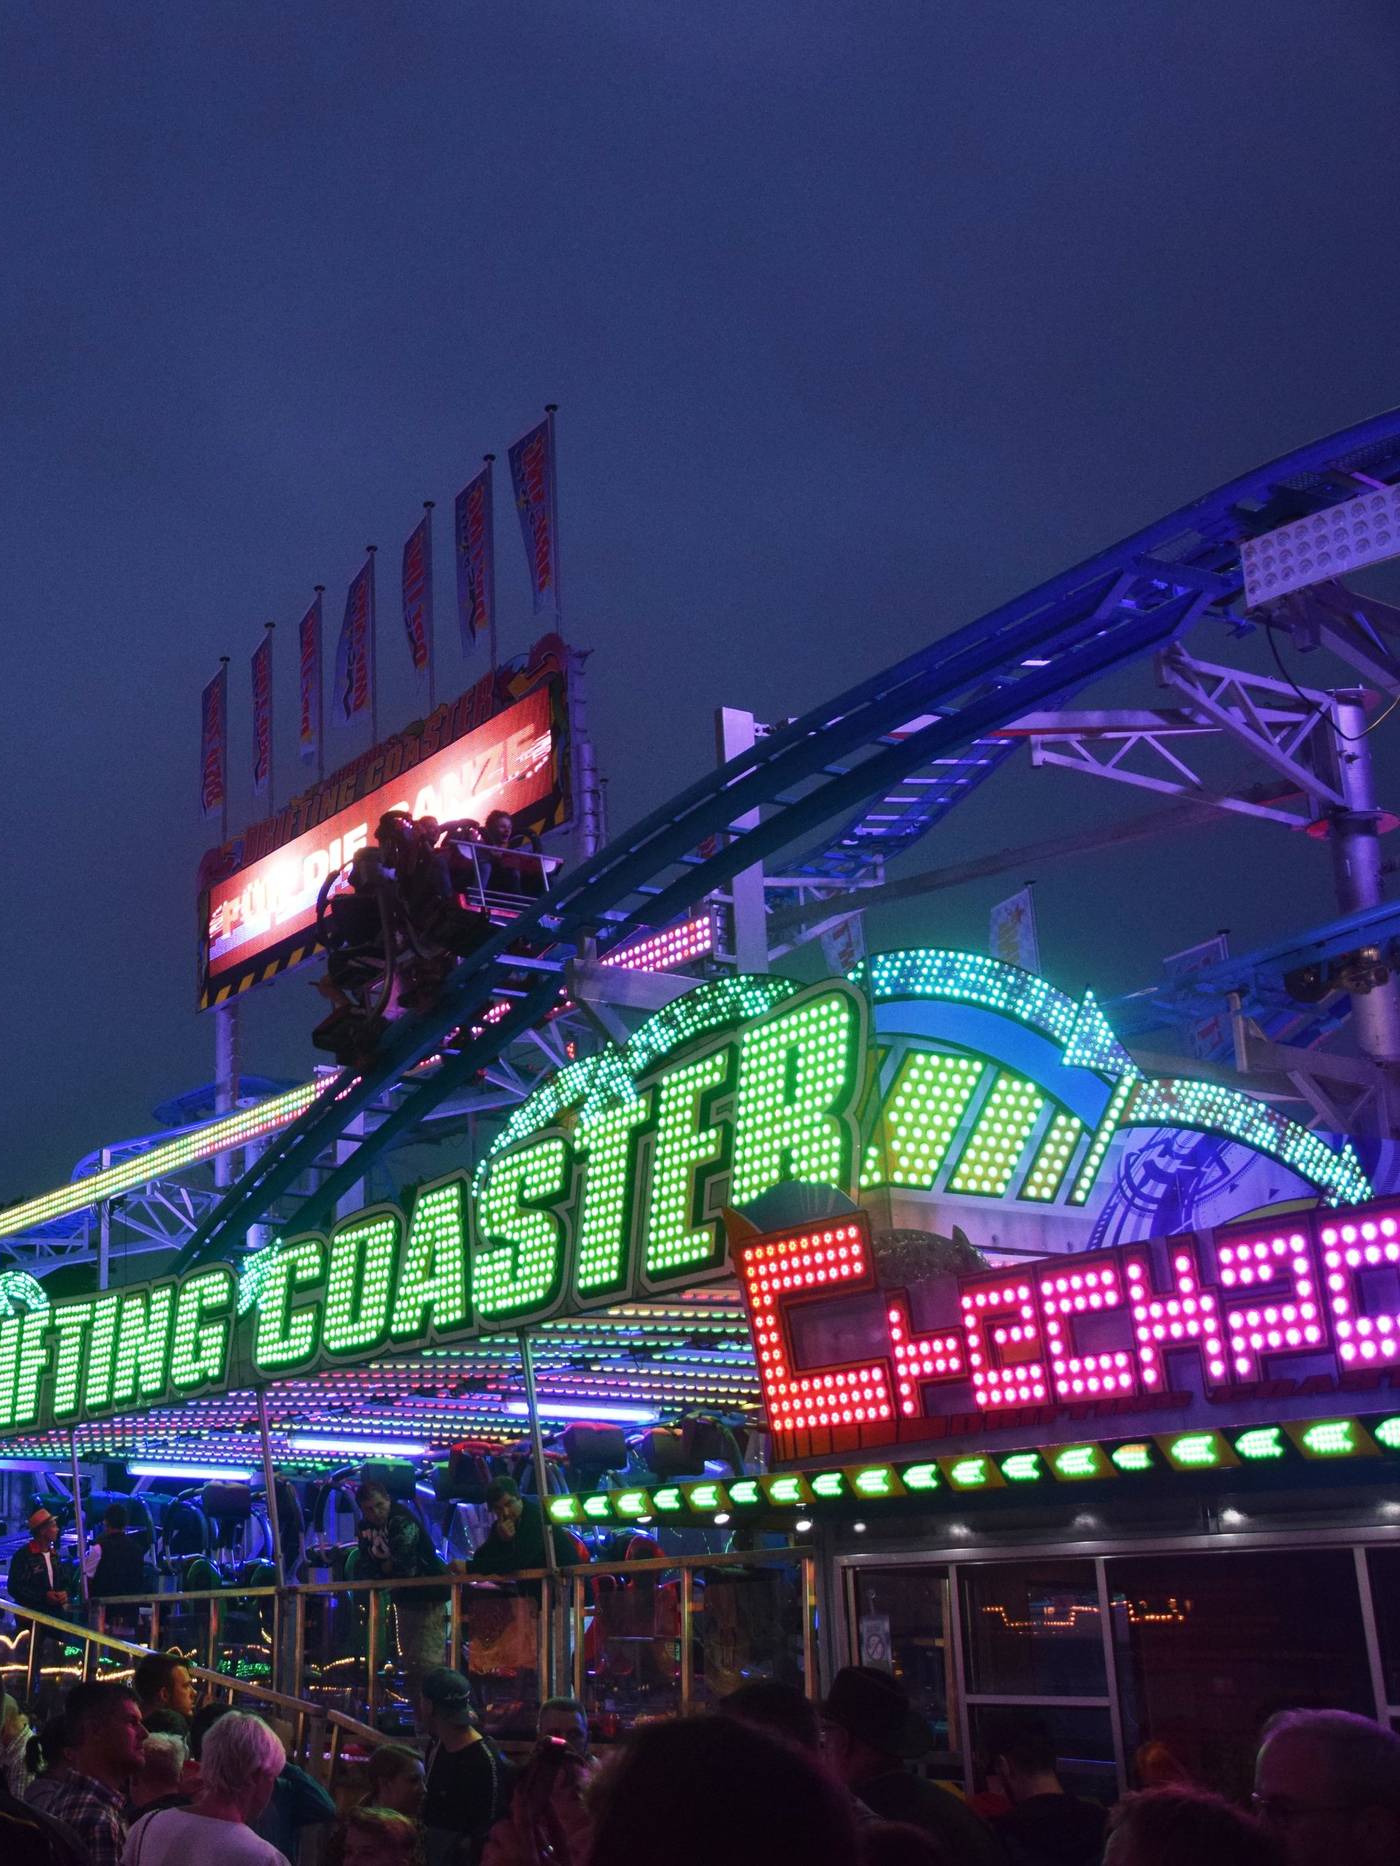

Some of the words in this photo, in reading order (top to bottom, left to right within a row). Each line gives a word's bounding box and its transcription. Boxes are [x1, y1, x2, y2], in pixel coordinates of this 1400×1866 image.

[242, 772, 355, 864] DRIFTING
[362, 671, 497, 799] COASTER
[388, 722, 537, 826] ANZE
[255, 998, 850, 1368] COASTER
